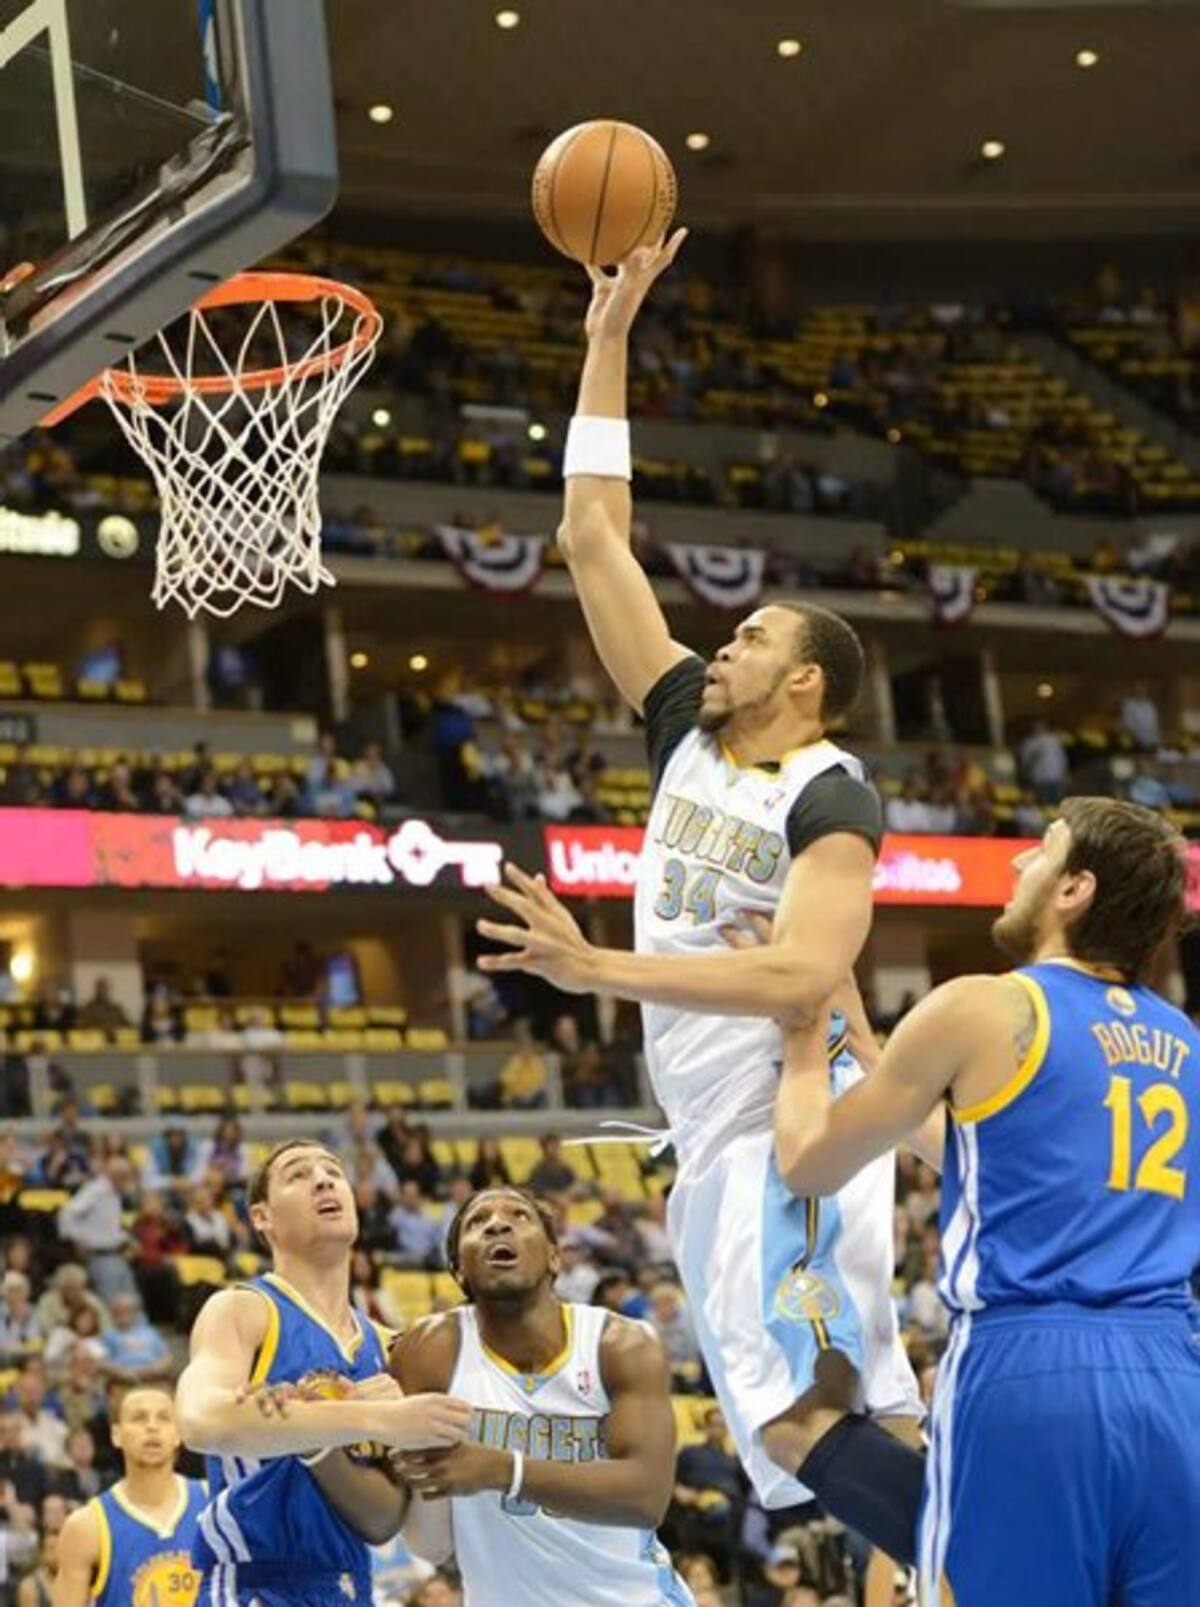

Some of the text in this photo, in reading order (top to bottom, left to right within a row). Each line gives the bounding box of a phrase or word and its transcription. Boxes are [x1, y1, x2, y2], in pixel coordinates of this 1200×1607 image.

[172, 826, 394, 889] KeyBank
[653, 792, 784, 883] NUGGETS
[654, 857, 723, 925] 34
[1091, 1019, 1190, 1080] BOGUT
[1103, 1074, 1189, 1202] 12
[168, 1571, 196, 1593] 30
